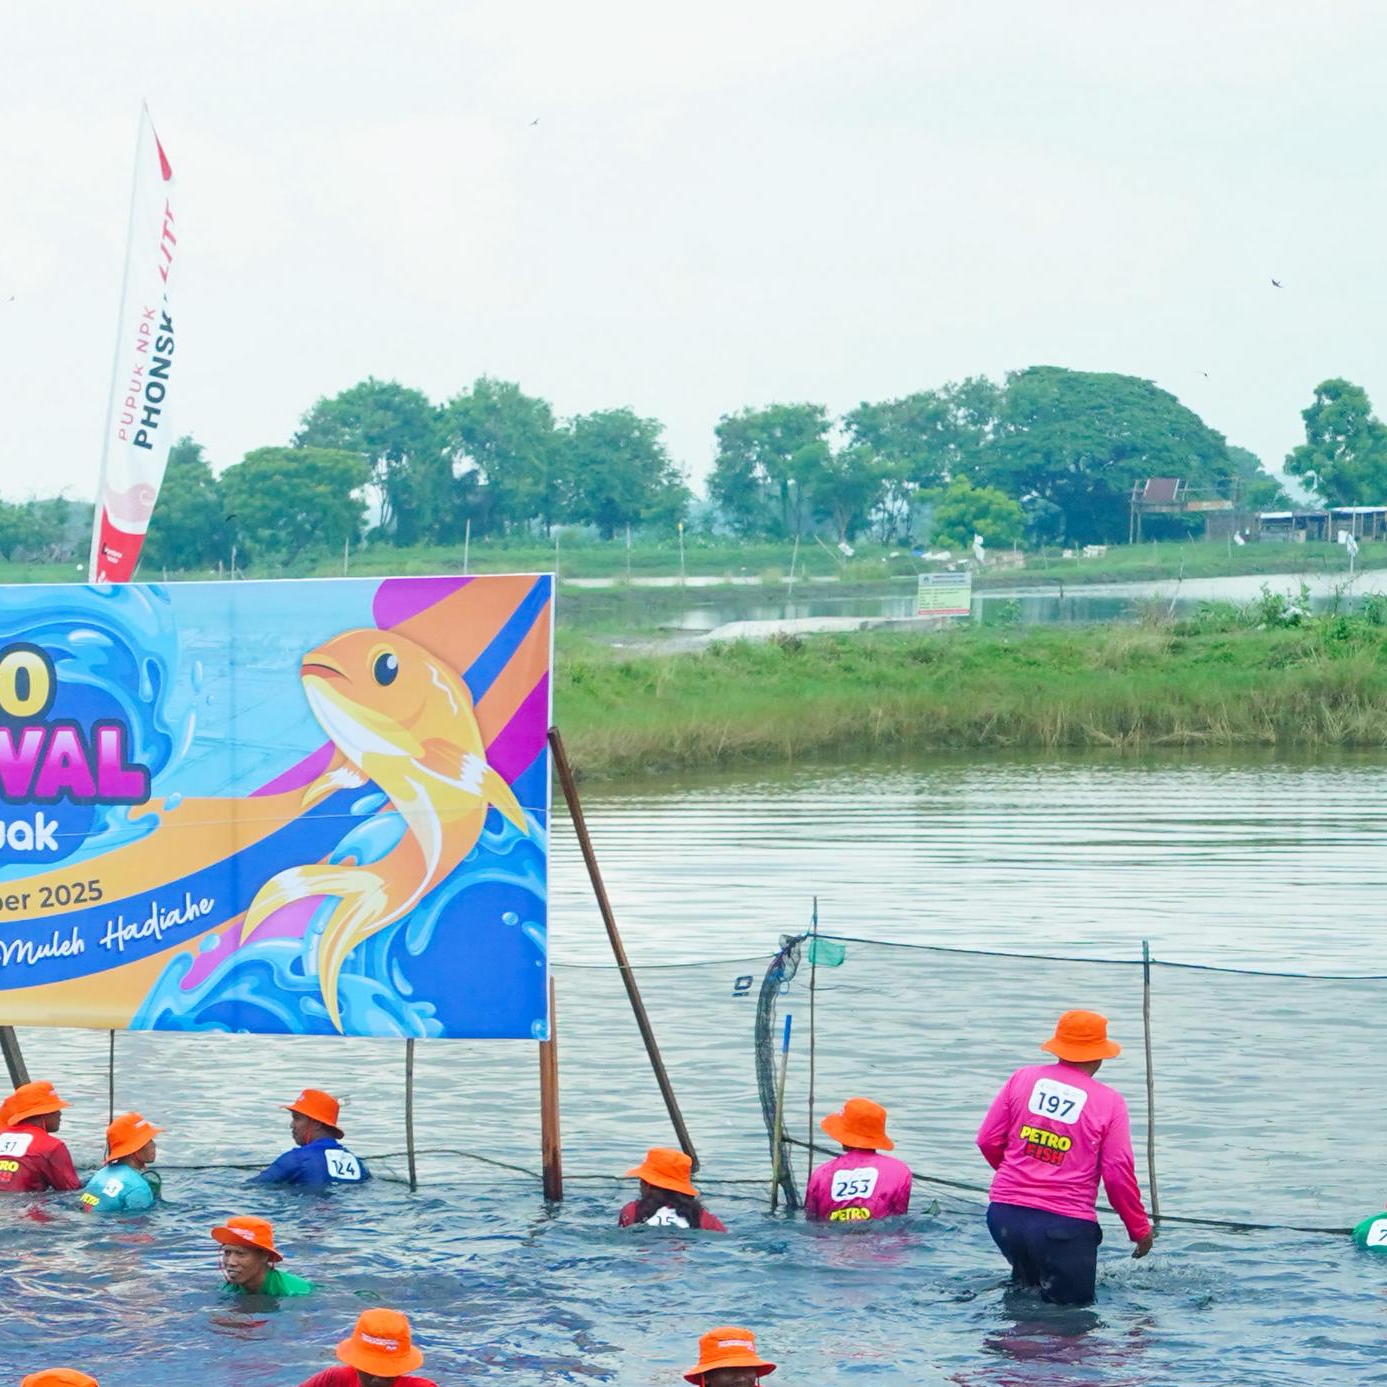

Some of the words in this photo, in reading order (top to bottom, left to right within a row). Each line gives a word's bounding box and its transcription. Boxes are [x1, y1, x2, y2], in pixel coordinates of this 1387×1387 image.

[38, 879, 104, 909] 2025
[99, 892, 215, 951] Hadiahe
[1037, 1091, 1077, 1118] 197
[1020, 1125, 1072, 1153] PETRO
[331, 1159, 356, 1177] 124
[1024, 1144, 1066, 1167] FISH
[836, 1178, 872, 1198] 253
[830, 1206, 871, 1221] PETRO
